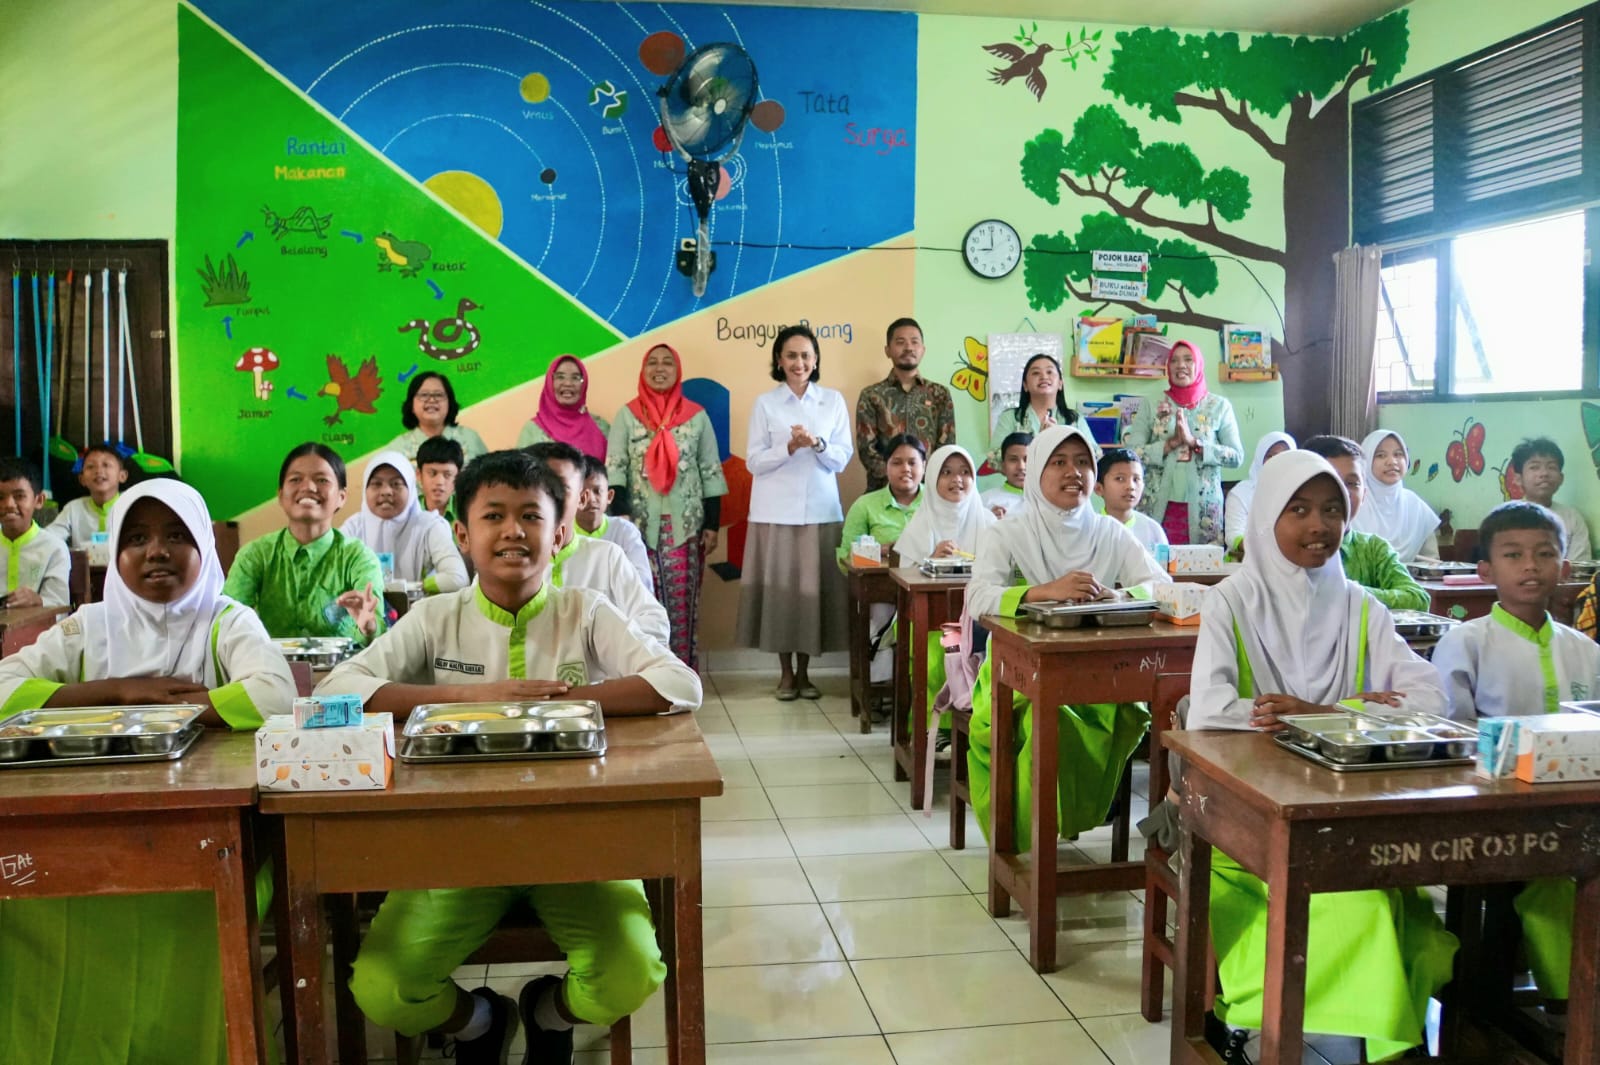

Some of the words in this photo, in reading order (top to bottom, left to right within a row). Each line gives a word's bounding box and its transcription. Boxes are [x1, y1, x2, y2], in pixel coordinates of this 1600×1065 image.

[797, 90, 850, 115] Tata
[522, 110, 555, 119] Venus
[287, 134, 346, 156] Rantai
[844, 121, 910, 155] Surga
[274, 165, 346, 181] Makanan
[1098, 253, 1122, 262] POJOK
[1123, 254, 1143, 263] BACA
[1370, 842, 1421, 866] SDN
[1430, 836, 1475, 862] CIR
[1523, 831, 1560, 855] PG
